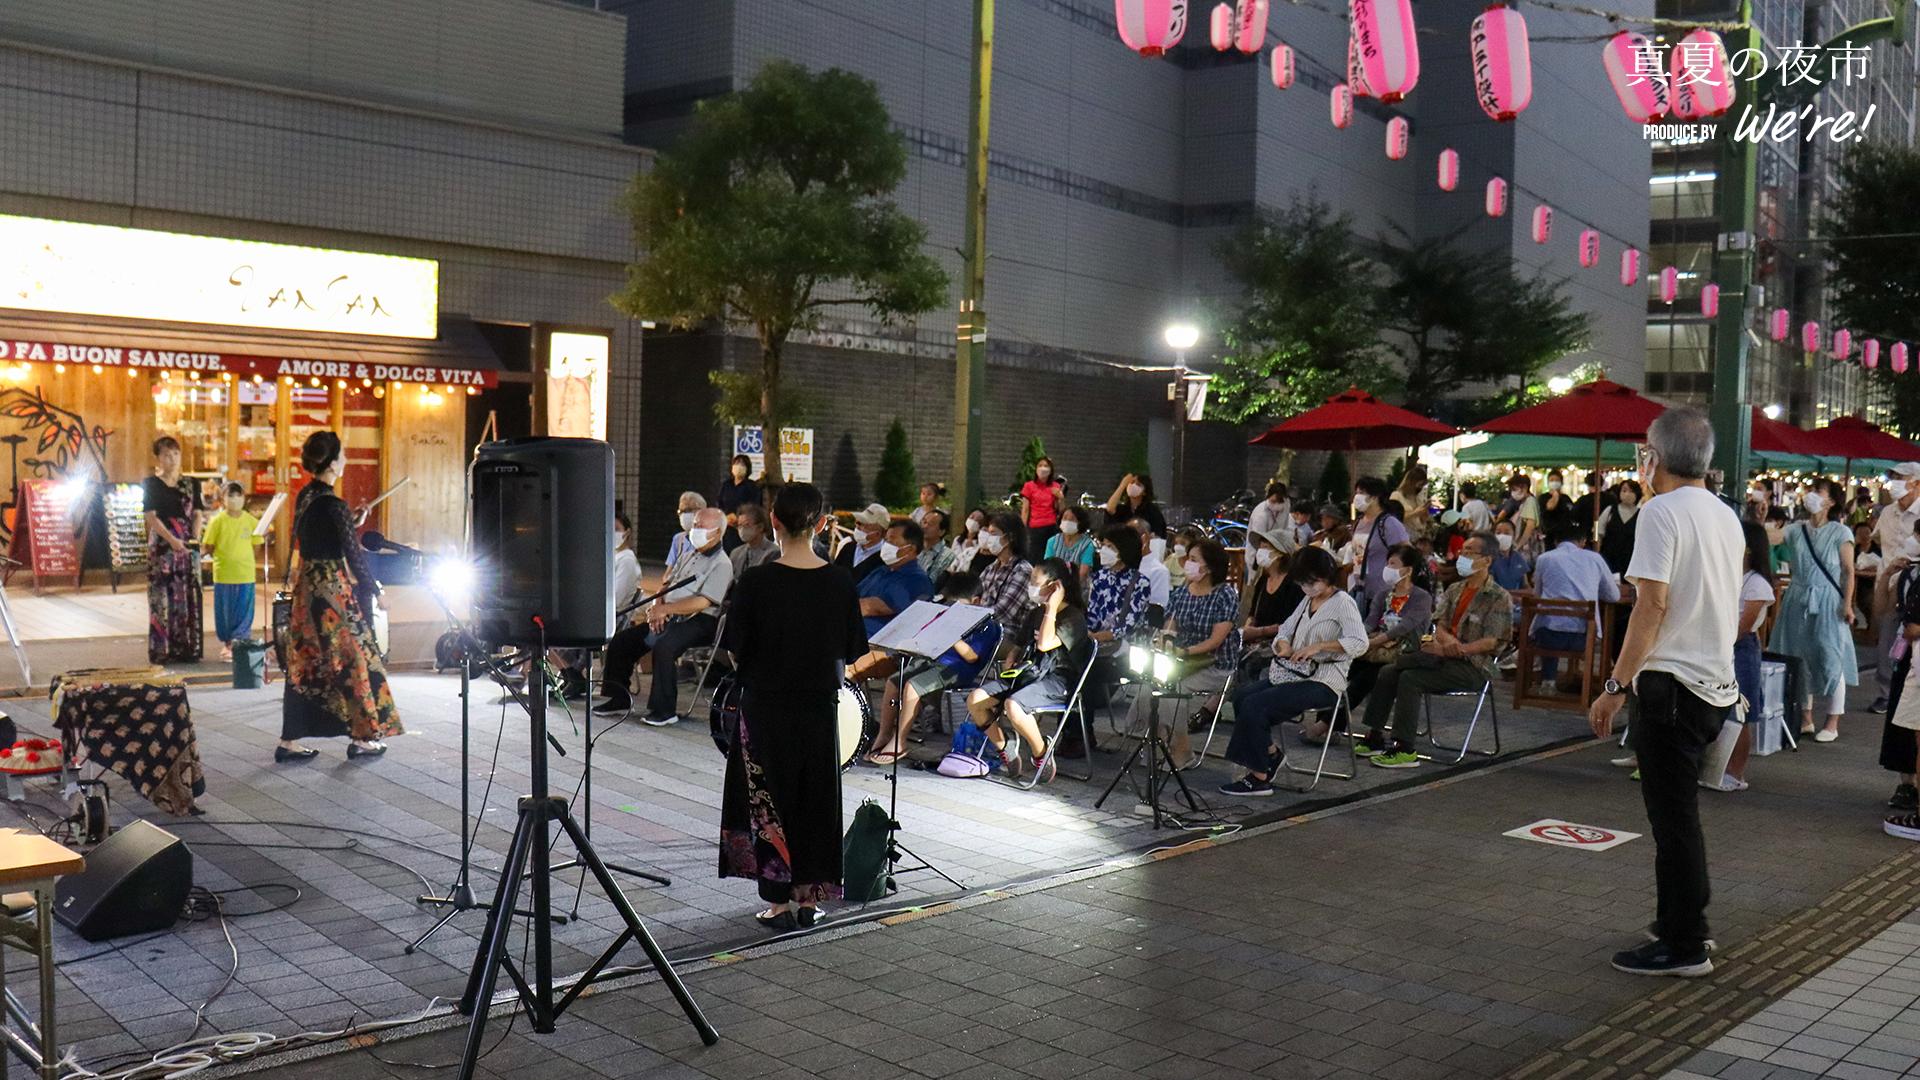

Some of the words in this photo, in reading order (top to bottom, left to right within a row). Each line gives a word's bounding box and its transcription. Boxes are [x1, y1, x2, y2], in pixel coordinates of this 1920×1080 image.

[1170, 0, 1185, 38] つり
[15, 343, 47, 361] FA
[52, 345, 123, 366] BUON
[128, 350, 226, 371] SANGUE.
[278, 359, 350, 378] AMORE
[355, 362, 369, 378] &
[374, 365, 436, 383] DOLCE
[440, 369, 485, 385] VITA
